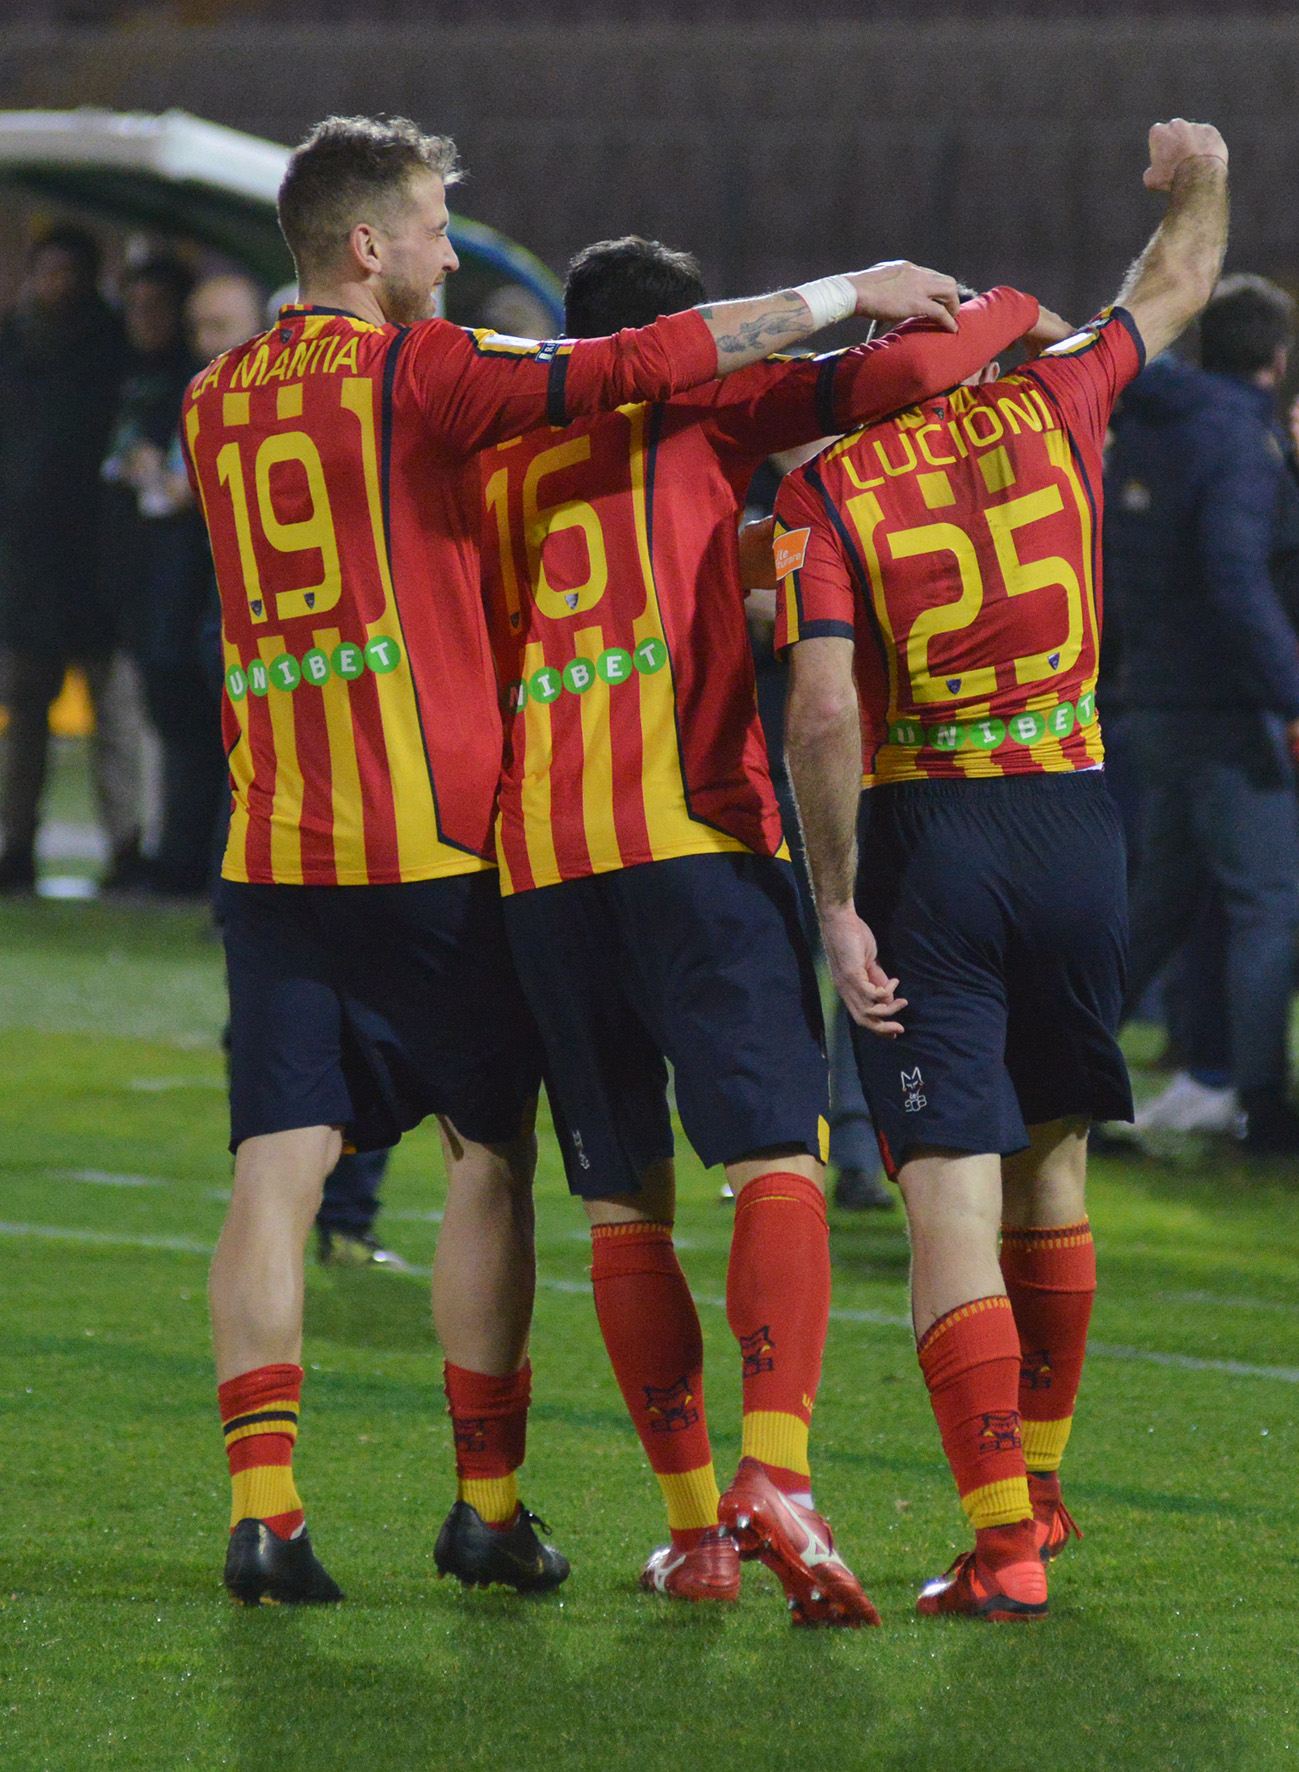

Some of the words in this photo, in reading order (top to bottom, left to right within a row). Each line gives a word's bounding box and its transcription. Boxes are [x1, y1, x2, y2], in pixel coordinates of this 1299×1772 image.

[191, 356, 229, 400] LA
[229, 335, 360, 388] MANTIA
[841, 390, 1055, 490] LUCIONI
[216, 431, 342, 625] 19
[485, 434, 608, 637] 16
[886, 483, 1084, 704] 25
[229, 641, 389, 696] UNIBET
[509, 643, 656, 708] NIBET
[895, 696, 1092, 746] UNIBET
